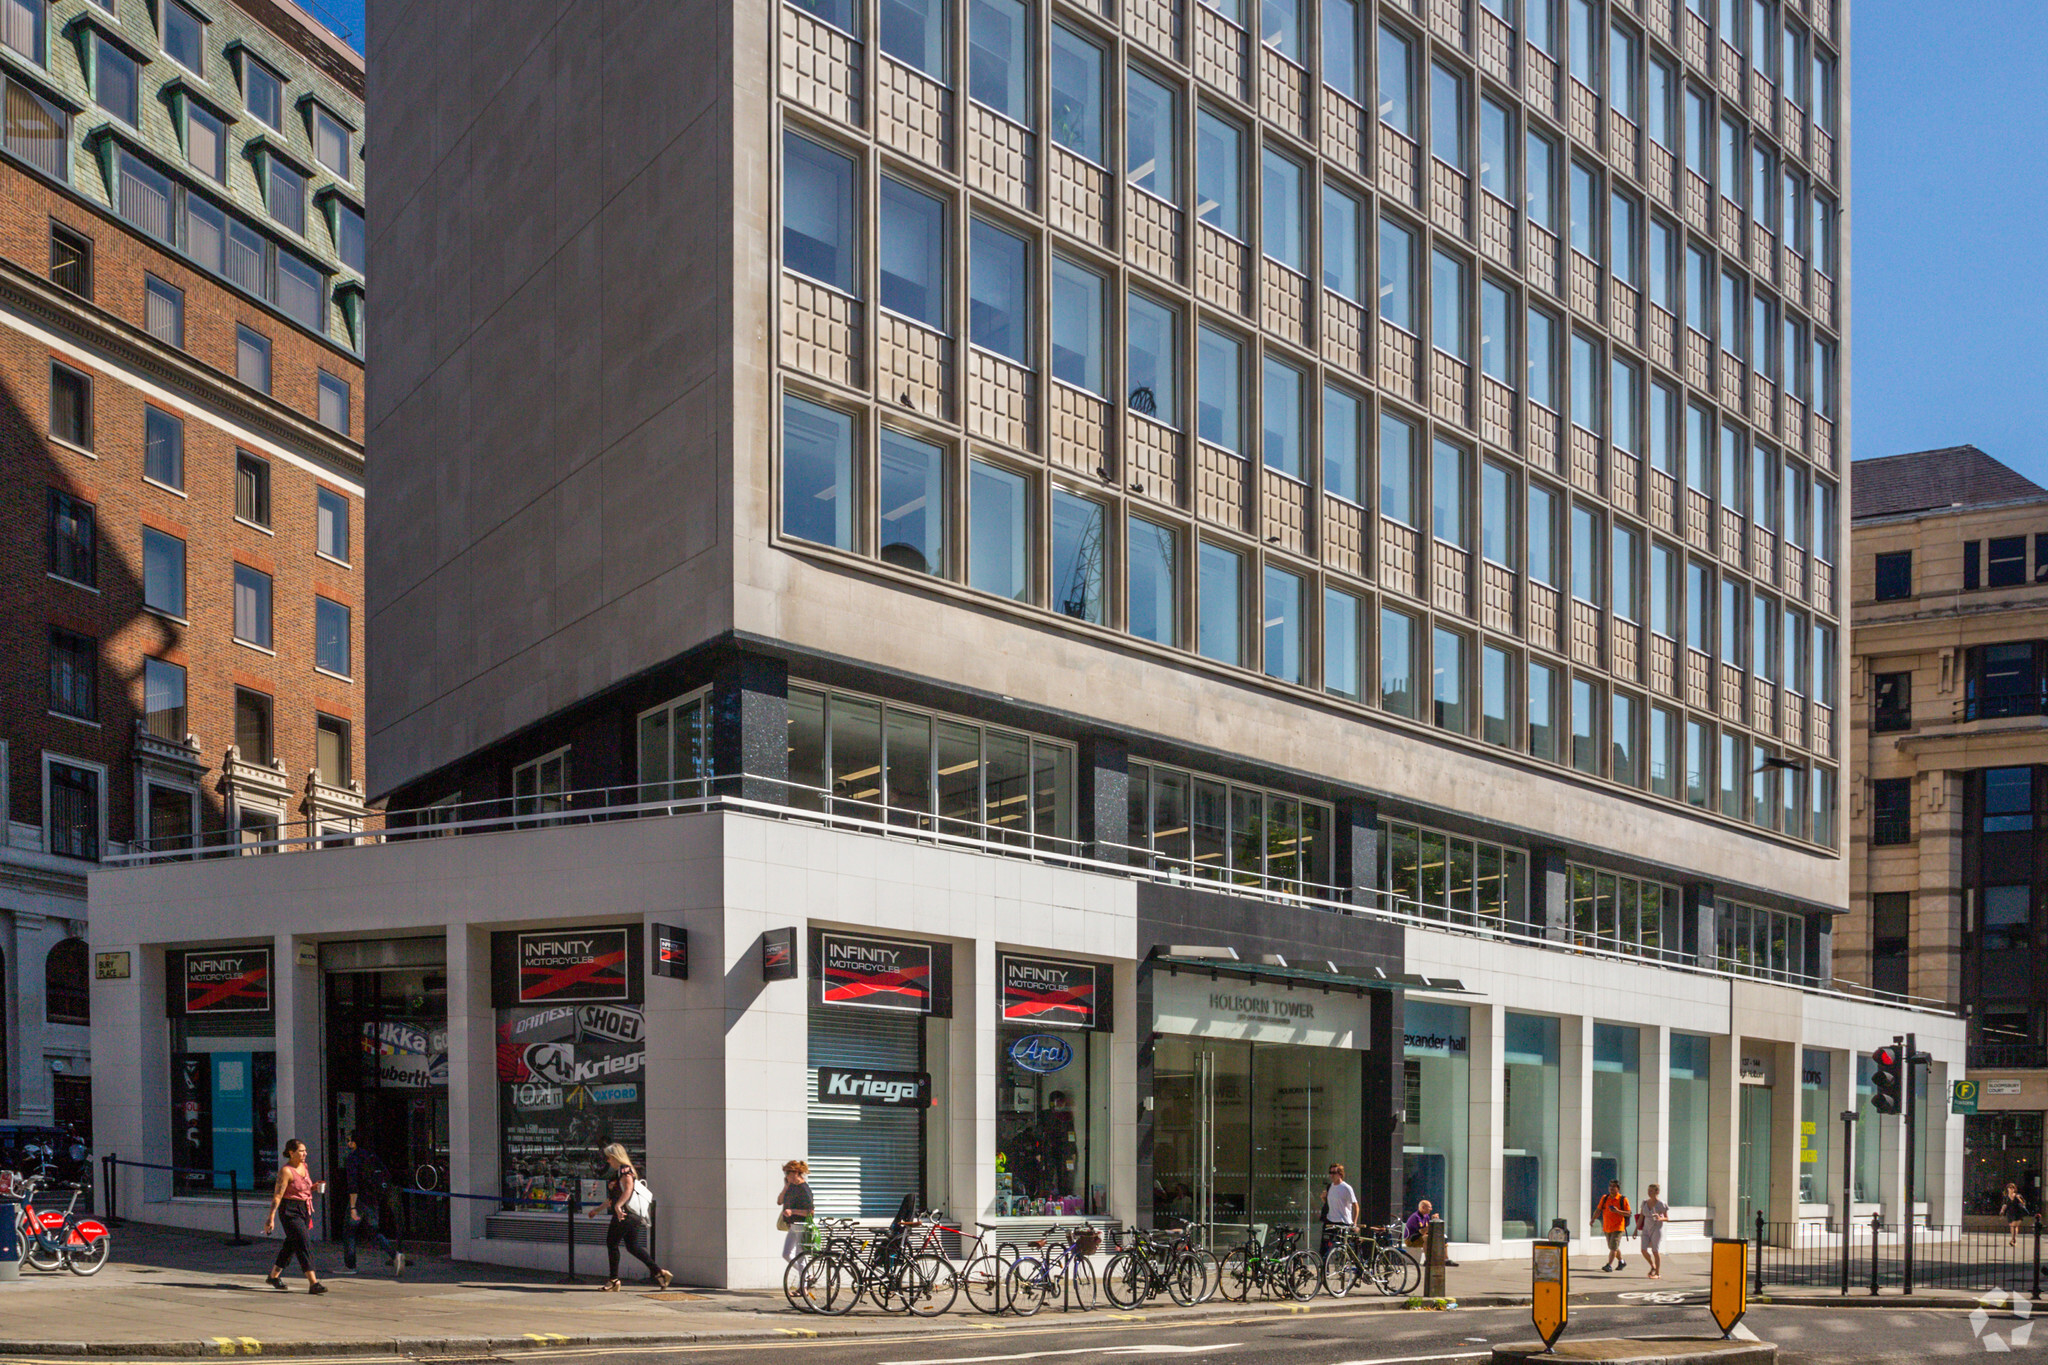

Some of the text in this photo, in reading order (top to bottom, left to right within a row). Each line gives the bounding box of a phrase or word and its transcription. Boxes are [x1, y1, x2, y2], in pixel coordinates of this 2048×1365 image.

[525, 940, 594, 957] INFINITY
[830, 943, 900, 964] INFINITY
[190, 958, 243, 973] INFINITY
[525, 955, 594, 967] MOTORCYCLES
[829, 959, 900, 974] MOTORCYCLES
[190, 972, 244, 981] MOTORCYCLES
[1009, 964, 1069, 983] INFINITY
[1009, 979, 1069, 992] MOTORCYCLES
[1210, 993, 1315, 1019] HOLBORN TOWER
[515, 1005, 574, 1034] DAINESE
[584, 1006, 640, 1040] SHOEI
[1449, 1034, 1466, 1051] hall
[594, 1088, 636, 1102] OXFORD
[827, 1073, 919, 1102] Kriega
[1961, 1085, 1970, 1097] F
